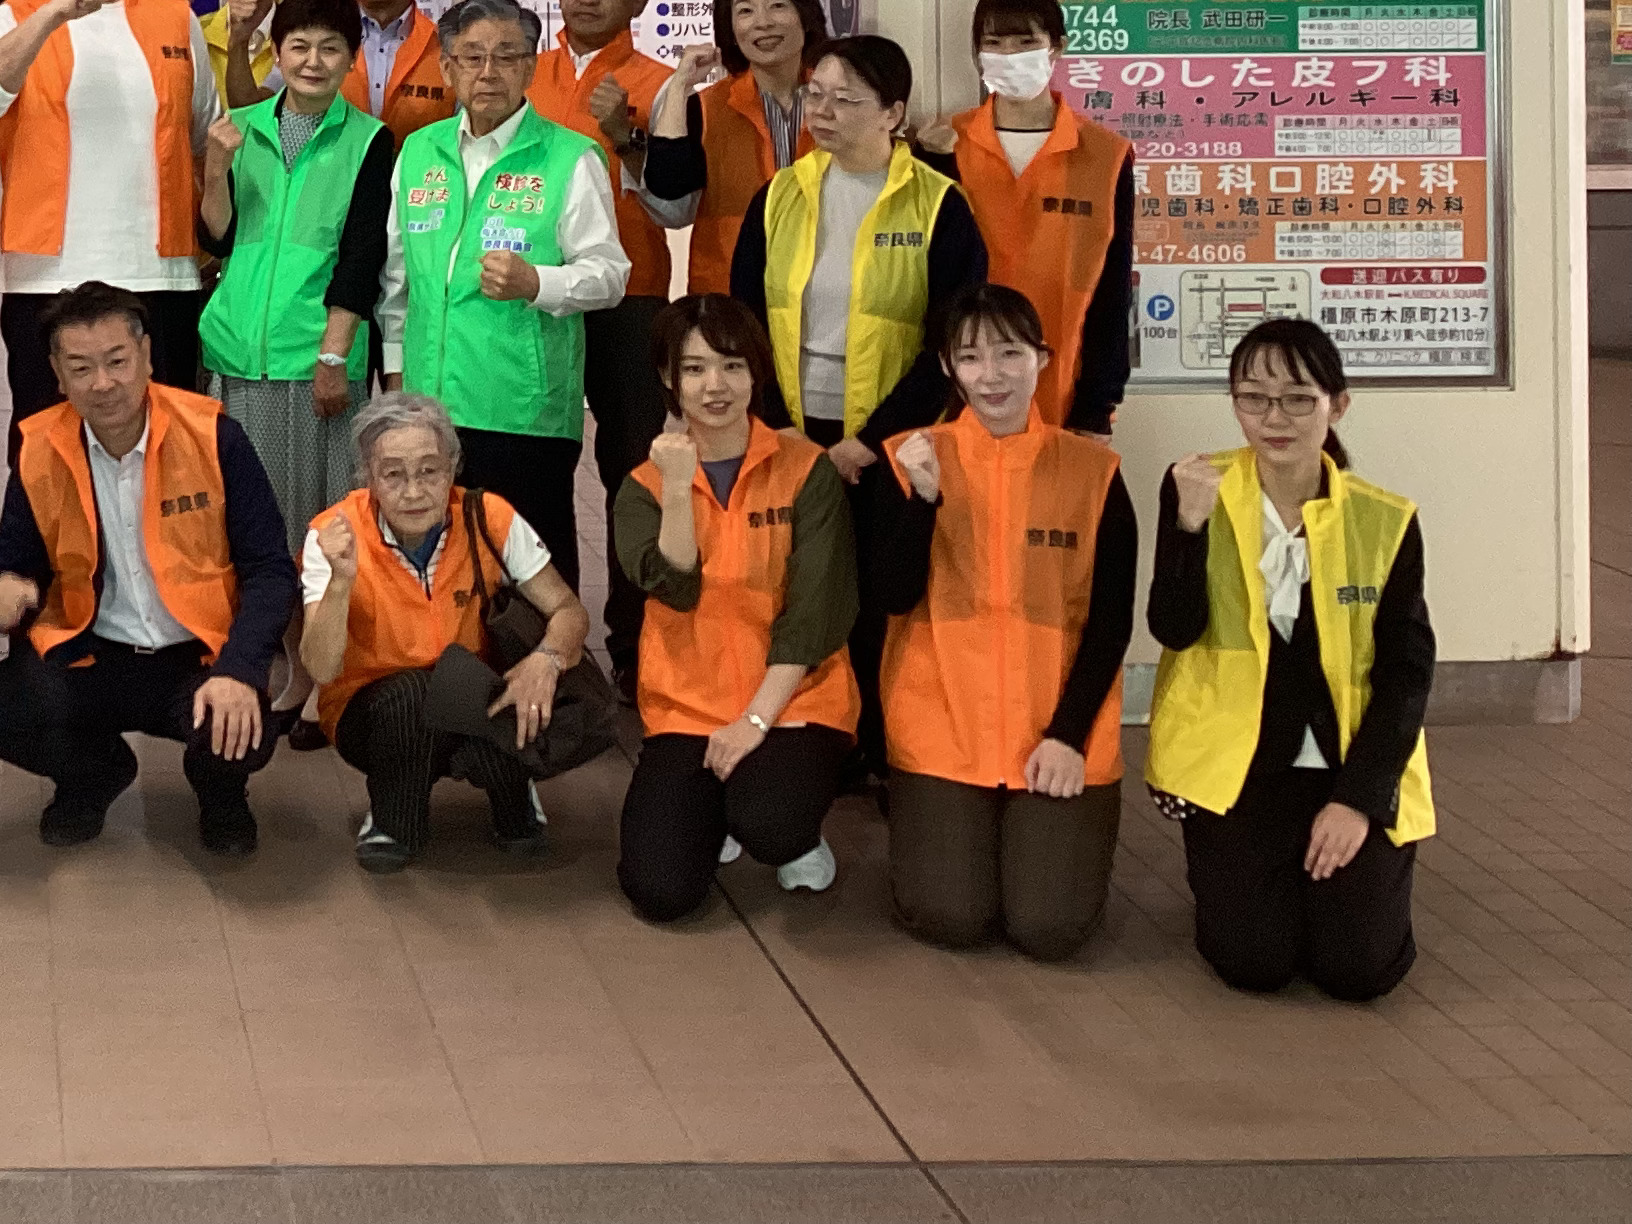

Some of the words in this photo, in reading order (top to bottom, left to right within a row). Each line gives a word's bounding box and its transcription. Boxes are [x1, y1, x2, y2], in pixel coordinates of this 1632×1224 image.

[1061, 5, 1118, 27] 744
[1148, 9, 1190, 30] 院長
[1202, 9, 1289, 30] 武田研一
[1068, 57, 1452, 88] きのした皮フ科
[496, 173, 544, 193] 検診を
[409, 188, 449, 205] 受けま
[489, 195, 544, 213] しょう!
[1141, 196, 1464, 217] 児歯科・矯正歯科・口腔外科
[874, 232, 923, 248] 奈良県
[1352, 269, 1459, 284] 送迎バス有り
[1321, 307, 1489, 325] 橿原市木原町213-7
[1143, 327, 1177, 339] 100台
[160, 491, 210, 517] 奈良県
[1027, 528, 1078, 549] 奈良県
